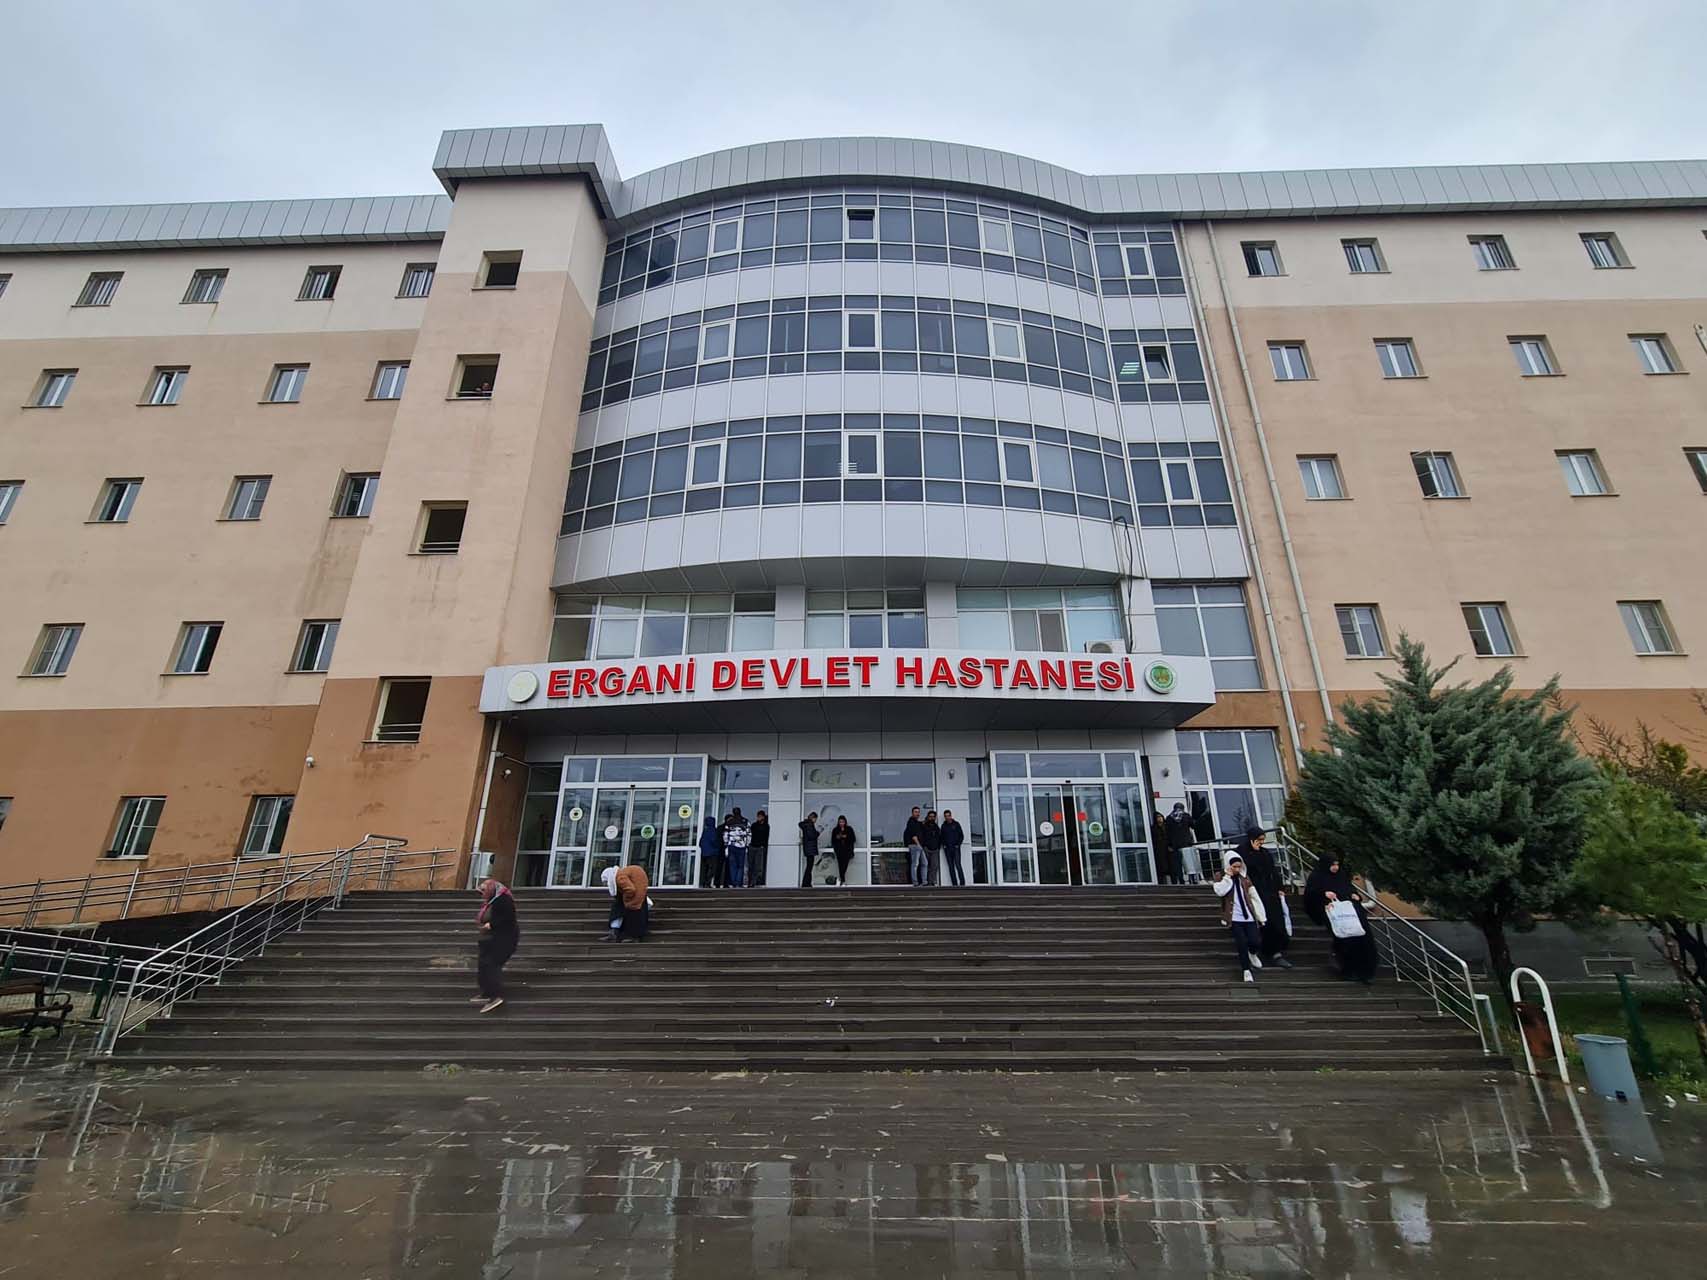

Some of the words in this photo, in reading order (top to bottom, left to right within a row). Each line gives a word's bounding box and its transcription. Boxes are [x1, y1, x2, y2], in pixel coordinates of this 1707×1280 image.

[547, 658, 696, 698] ERGANİ
[712, 656, 880, 690] DEVLET
[896, 656, 1135, 690] HASTANESİ
